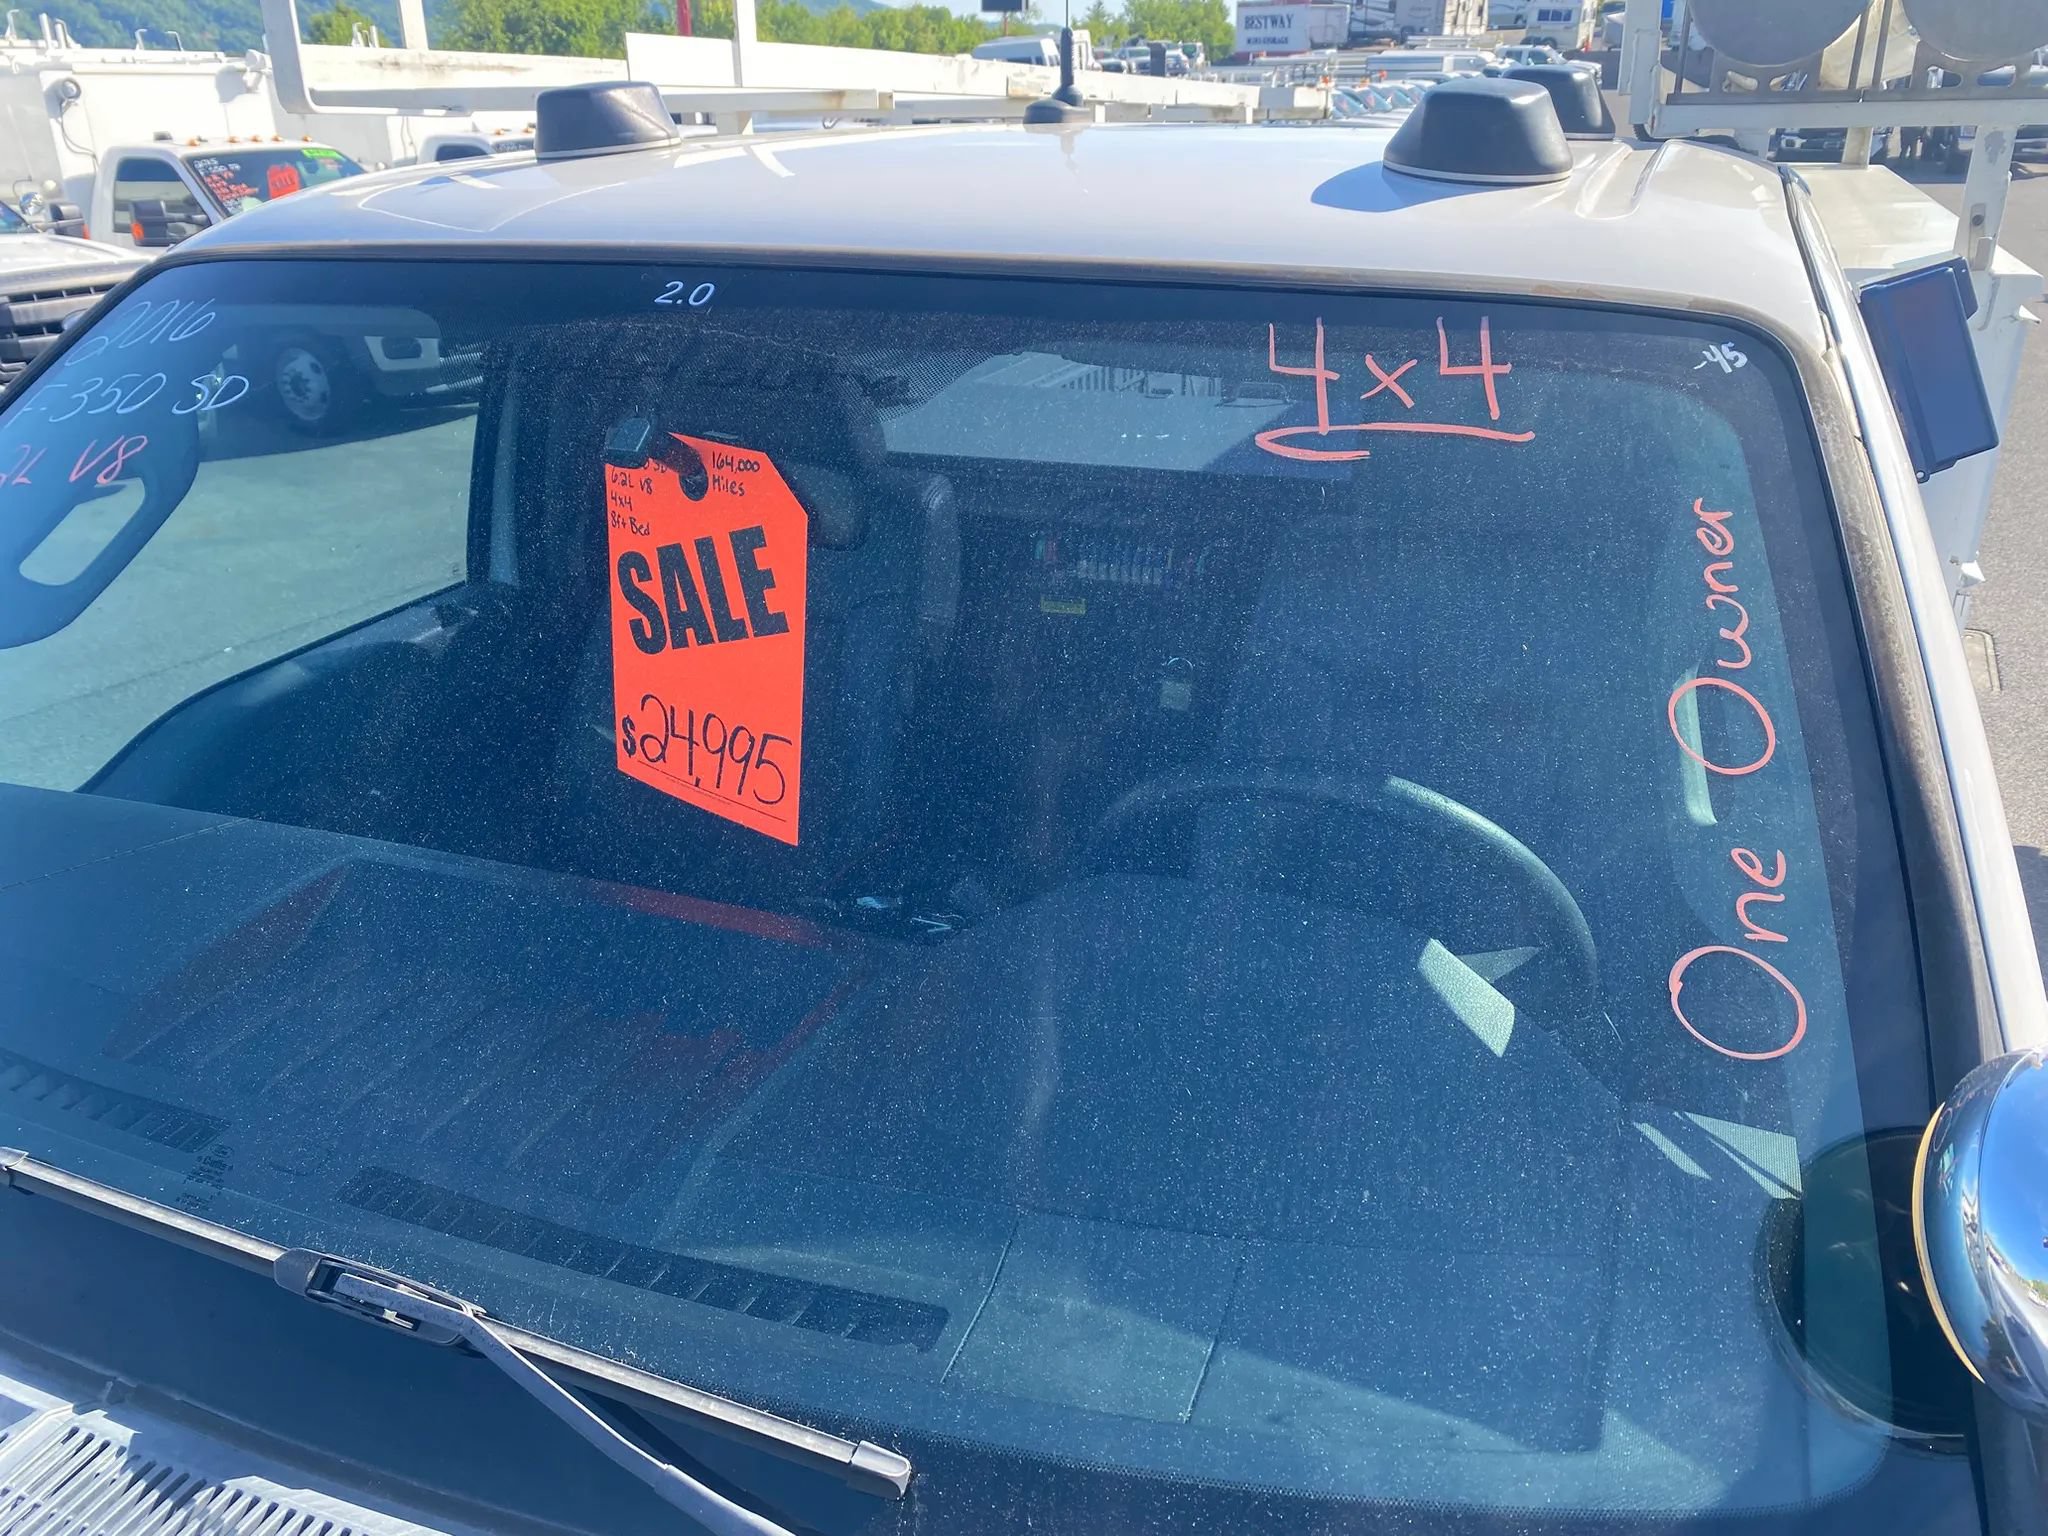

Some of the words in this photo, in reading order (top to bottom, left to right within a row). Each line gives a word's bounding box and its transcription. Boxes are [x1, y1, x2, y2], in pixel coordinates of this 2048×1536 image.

[1244, 13, 1294, 30] BESTWAY
[653, 280, 715, 306] 2.0
[64, 298, 216, 367] 2016
[171, 374, 249, 415] SD
[68, 434, 149, 485] V8
[712, 451, 761, 474] 164,000
[712, 474, 746, 496] Miles
[629, 516, 651, 537] Bed
[617, 525, 790, 655] SALE
[1668, 497, 1776, 776] Owner
[621, 693, 793, 805] $24,995
[1668, 847, 1808, 1061] One
